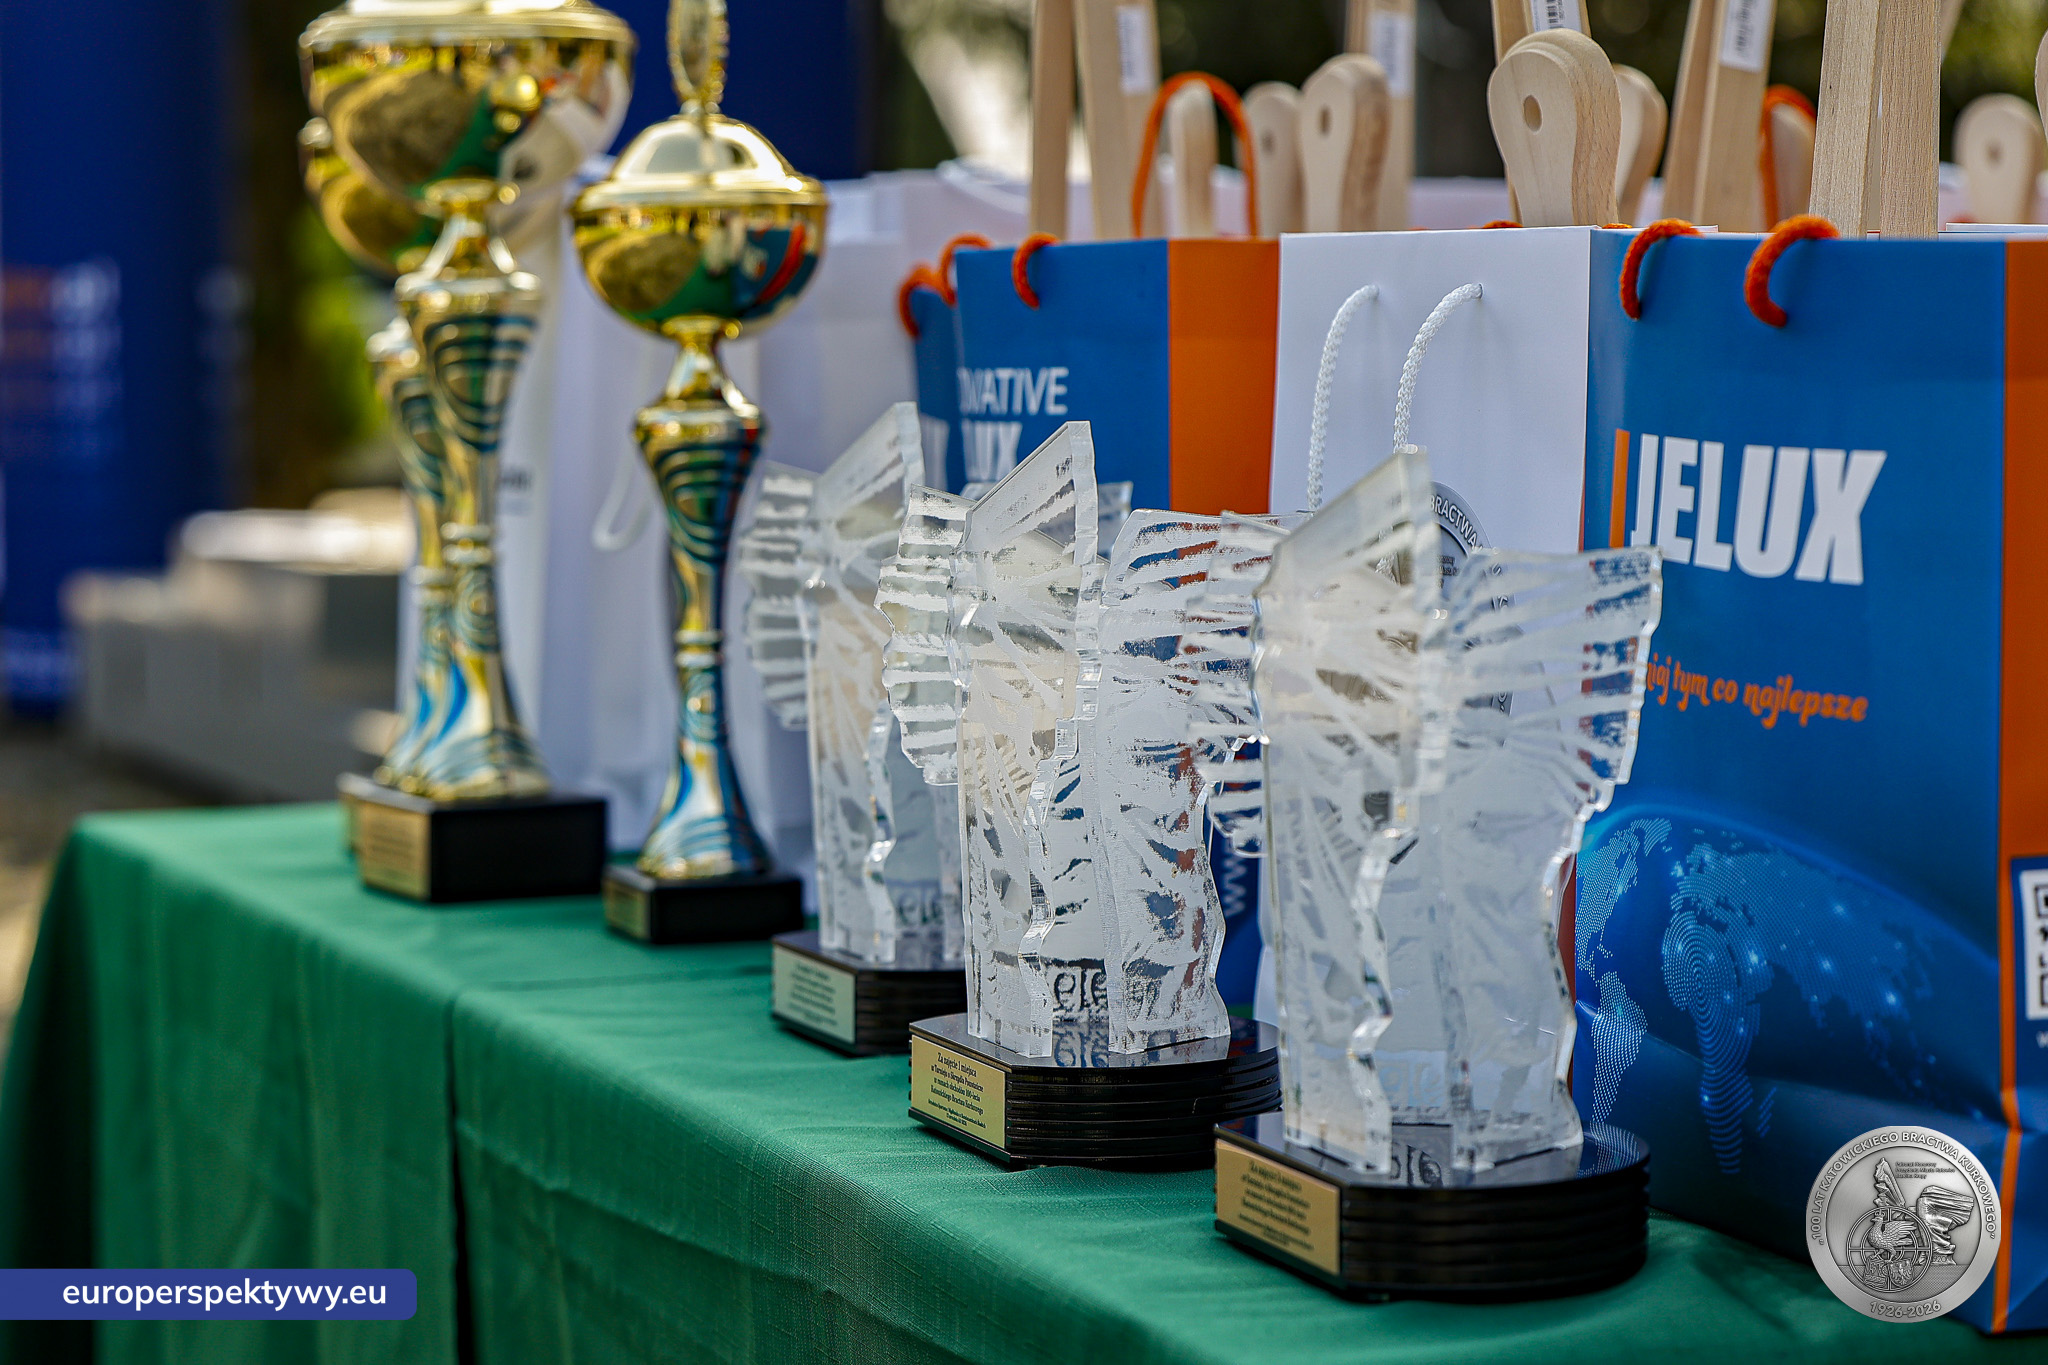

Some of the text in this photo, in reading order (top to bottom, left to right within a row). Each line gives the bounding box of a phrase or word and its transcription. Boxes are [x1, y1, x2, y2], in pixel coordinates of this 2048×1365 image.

[1673, 661, 1711, 712] tym
[1712, 677, 1738, 703] co
[1743, 674, 1869, 729] najlepsze
